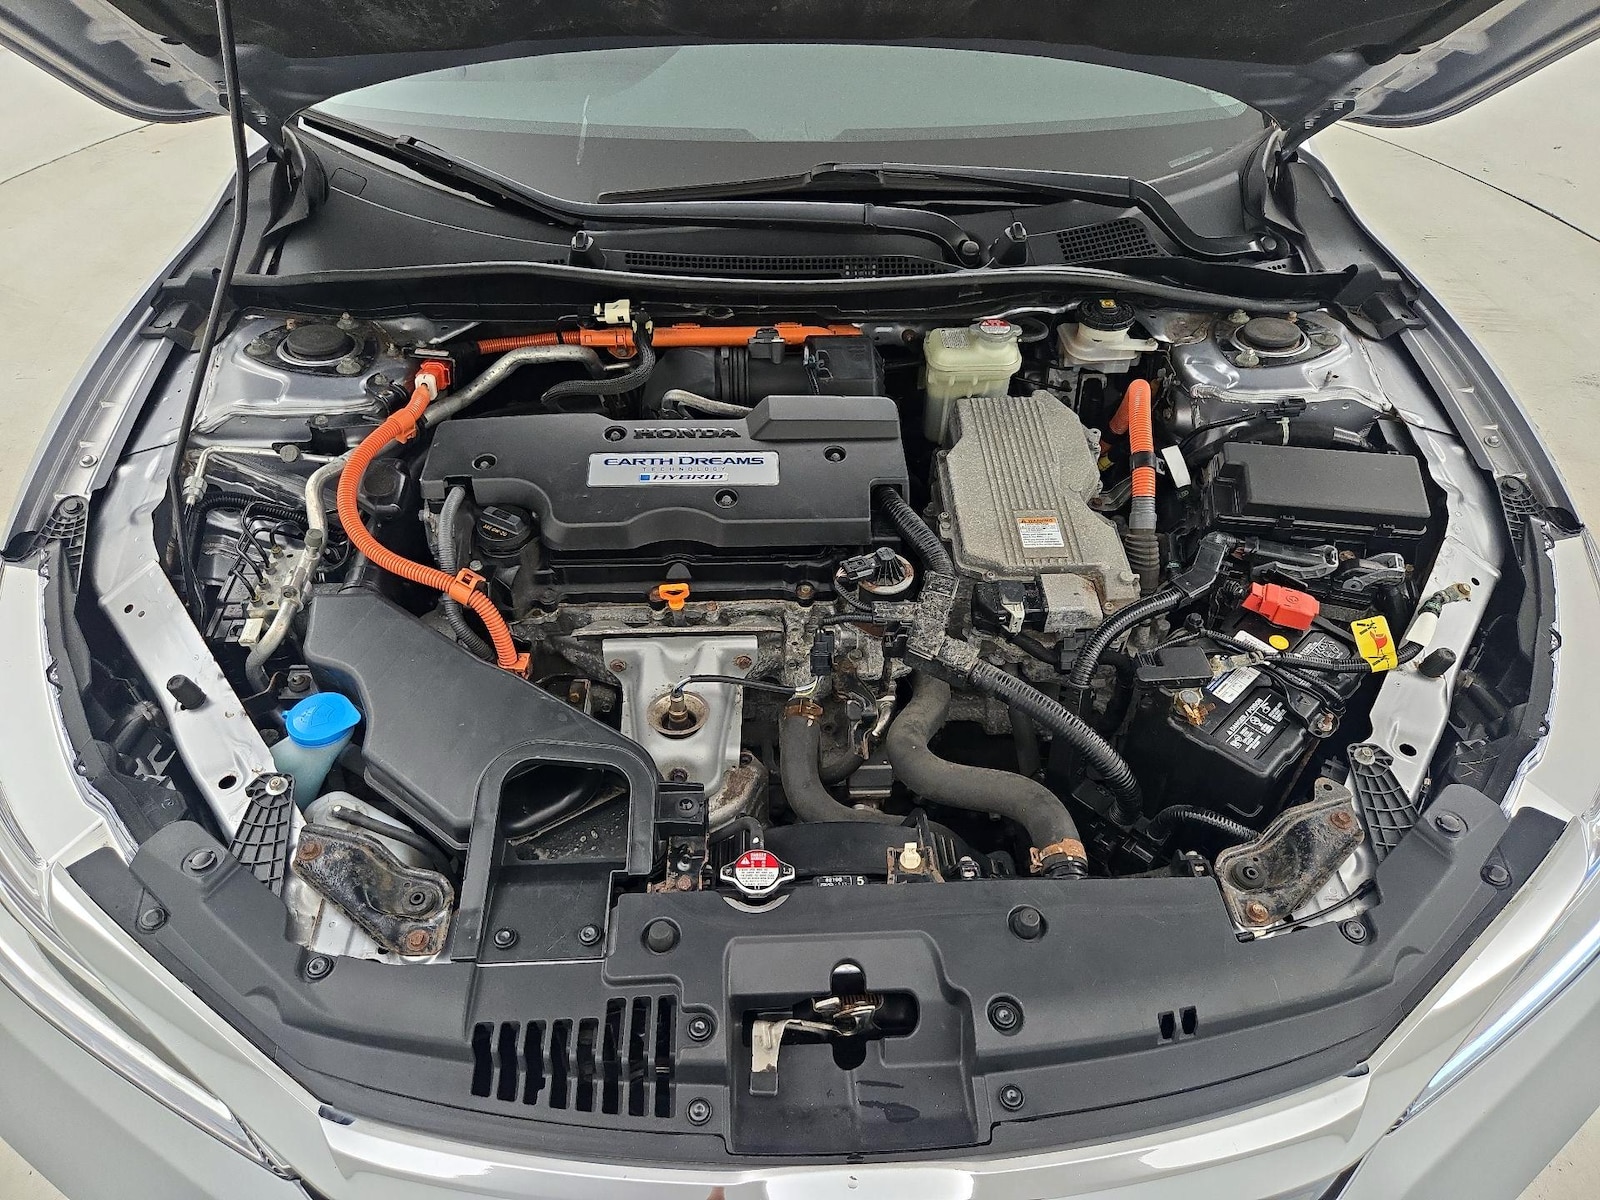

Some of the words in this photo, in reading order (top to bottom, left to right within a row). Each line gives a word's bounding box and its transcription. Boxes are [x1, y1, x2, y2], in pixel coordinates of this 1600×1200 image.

[633, 427, 741, 440] HONDA
[604, 457, 673, 466] EARTH
[678, 456, 765, 466] DREAMS
[856, 875, 865, 886] 5
